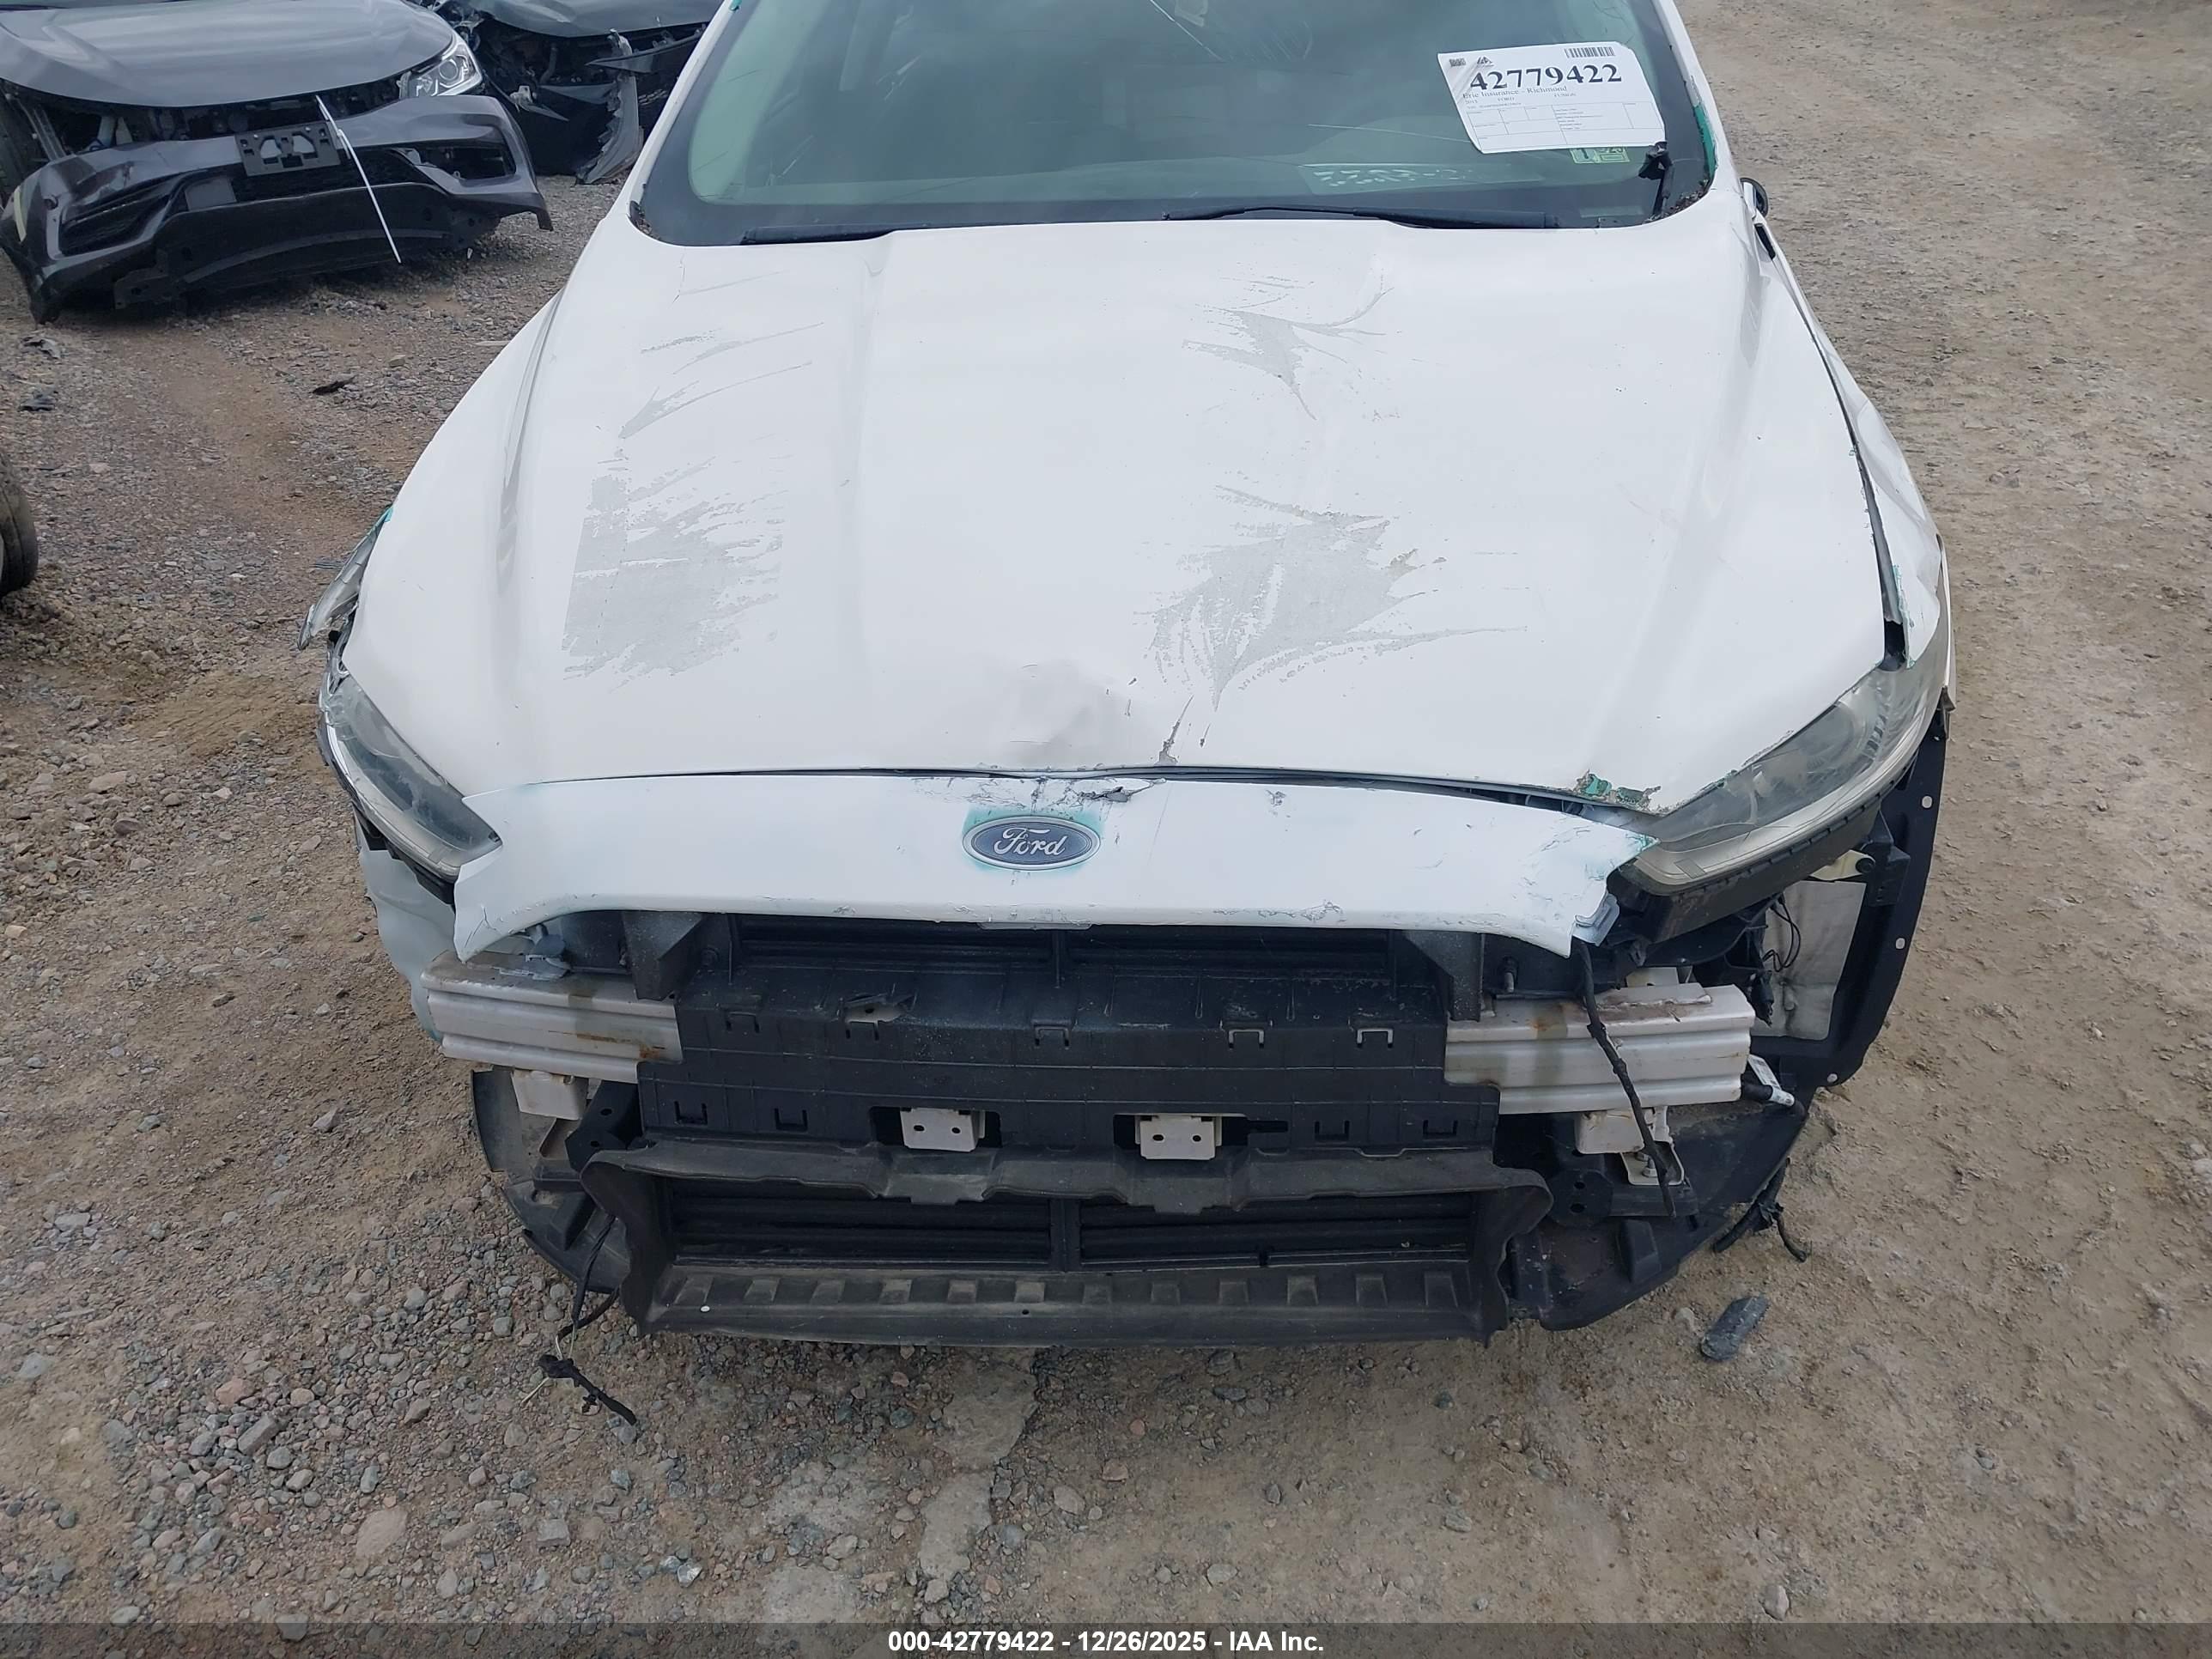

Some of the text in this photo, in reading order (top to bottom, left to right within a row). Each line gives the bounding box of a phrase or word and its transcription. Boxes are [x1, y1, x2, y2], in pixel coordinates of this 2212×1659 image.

[1470, 64, 1622, 90] 42779422
[1527, 85, 1567, 94] Richmond
[993, 826, 1067, 856] Ford
